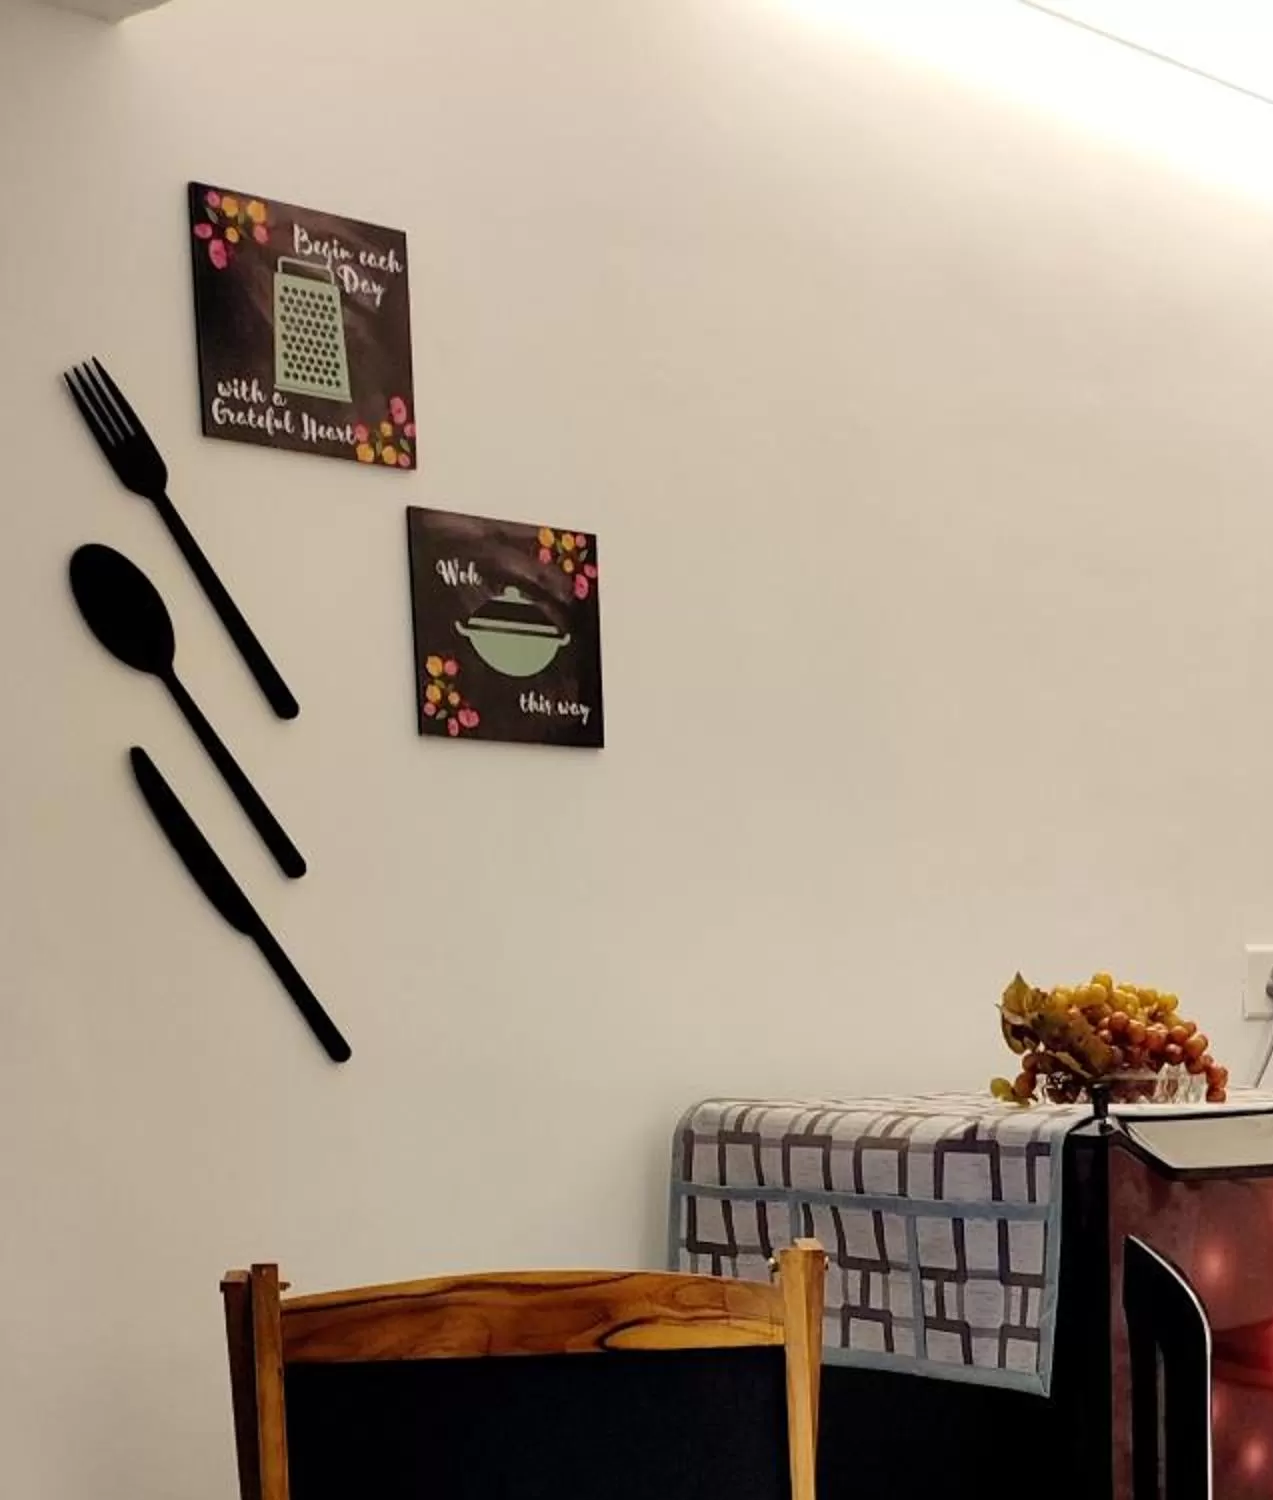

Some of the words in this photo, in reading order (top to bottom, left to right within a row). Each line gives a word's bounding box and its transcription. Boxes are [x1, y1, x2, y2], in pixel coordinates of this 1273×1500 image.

[293, 223, 354, 267] Begin
[359, 248, 404, 273] each
[336, 264, 386, 308] Day
[217, 378, 266, 403] with
[272, 391, 288, 407] a
[211, 397, 295, 437] Grateful
[301, 411, 358, 444] Heart
[519, 691, 551, 716] this
[557, 700, 592, 726] way
